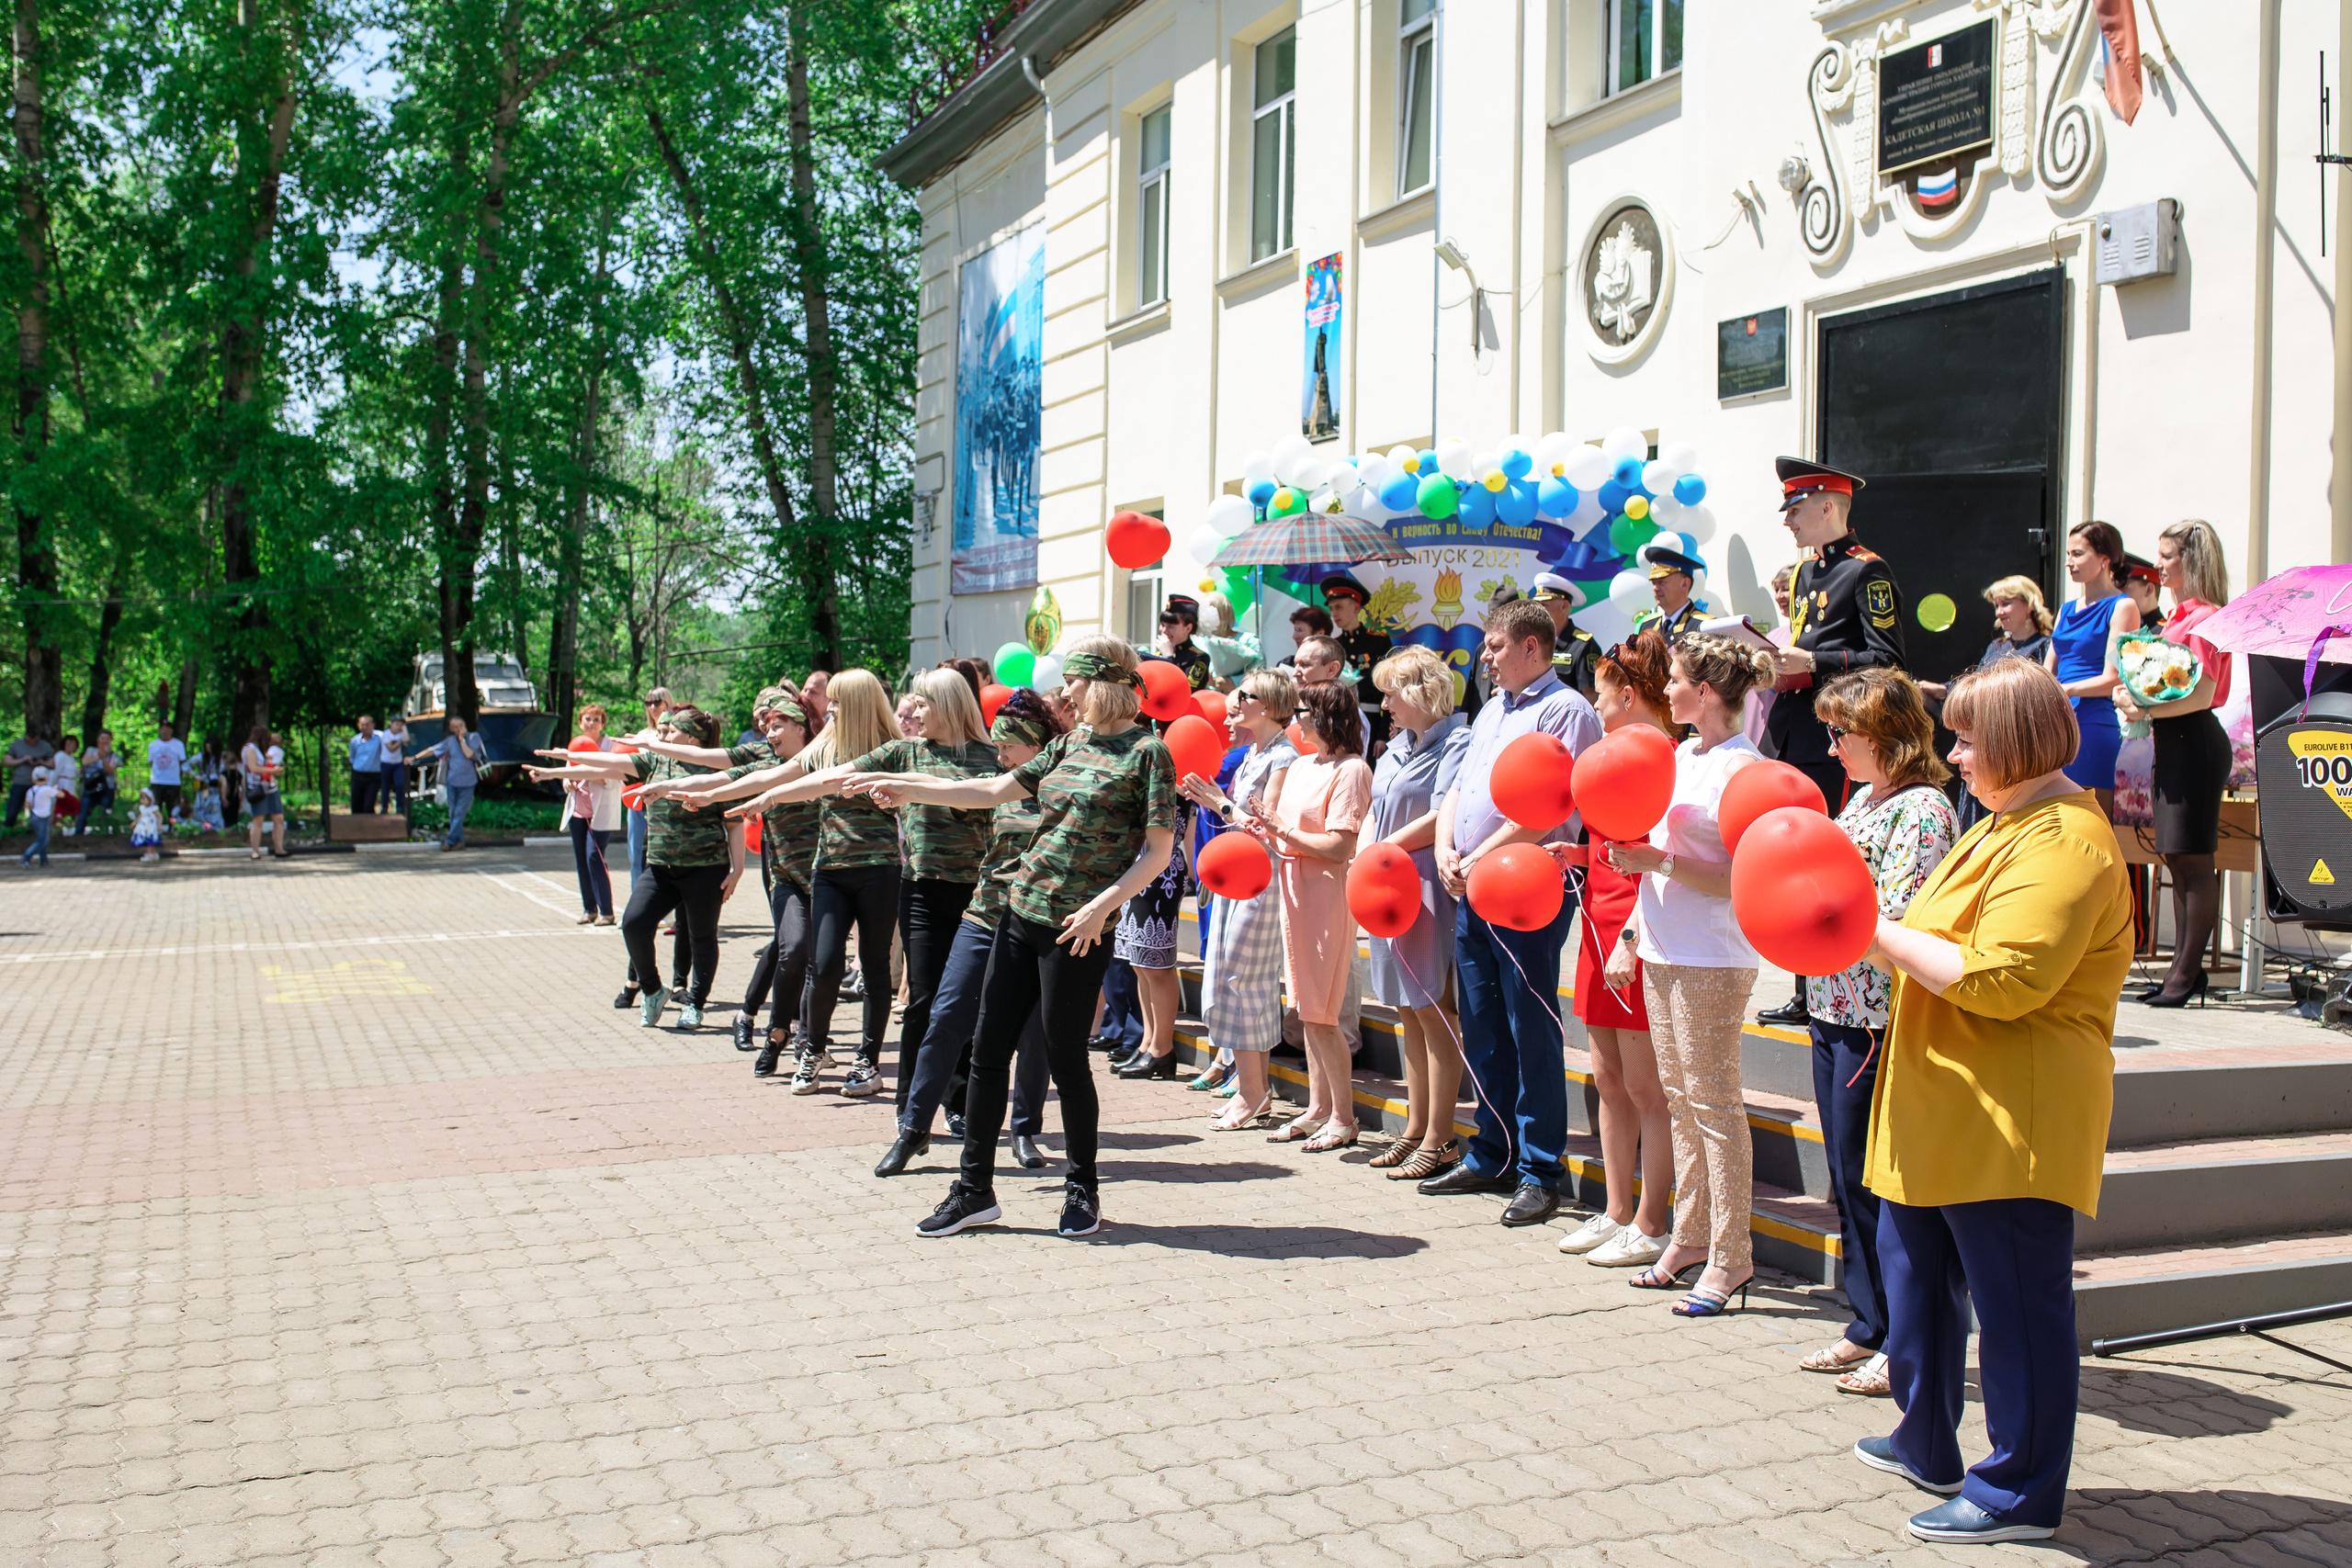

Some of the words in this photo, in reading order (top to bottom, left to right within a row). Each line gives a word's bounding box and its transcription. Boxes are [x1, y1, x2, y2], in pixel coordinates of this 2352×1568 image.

[1884, 121, 1936, 146] КАДЕТСКАЯ
[1938, 110, 1971, 129] ШКОЛА
[1493, 522, 1543, 540] Отечества!
[1472, 549, 1520, 568] 2021
